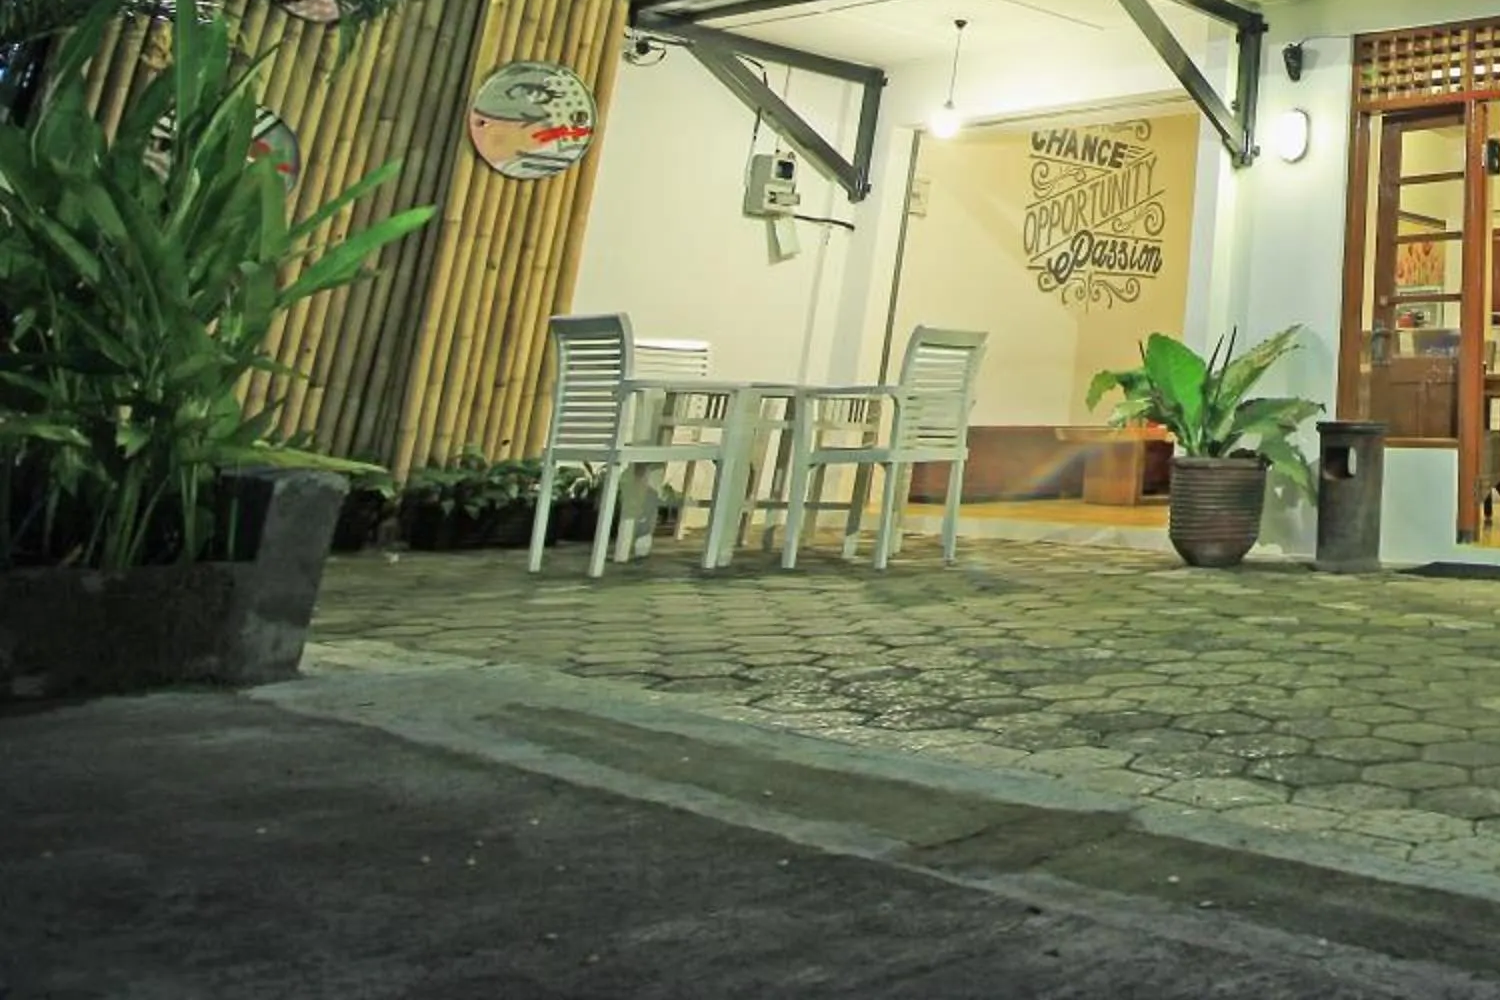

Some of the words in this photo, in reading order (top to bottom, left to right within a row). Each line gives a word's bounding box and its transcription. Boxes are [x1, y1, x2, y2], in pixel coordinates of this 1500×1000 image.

[1032, 129, 1128, 169] CHANCE
[1023, 156, 1158, 255] OPPORTUNITY
[1047, 230, 1163, 285] Passion
